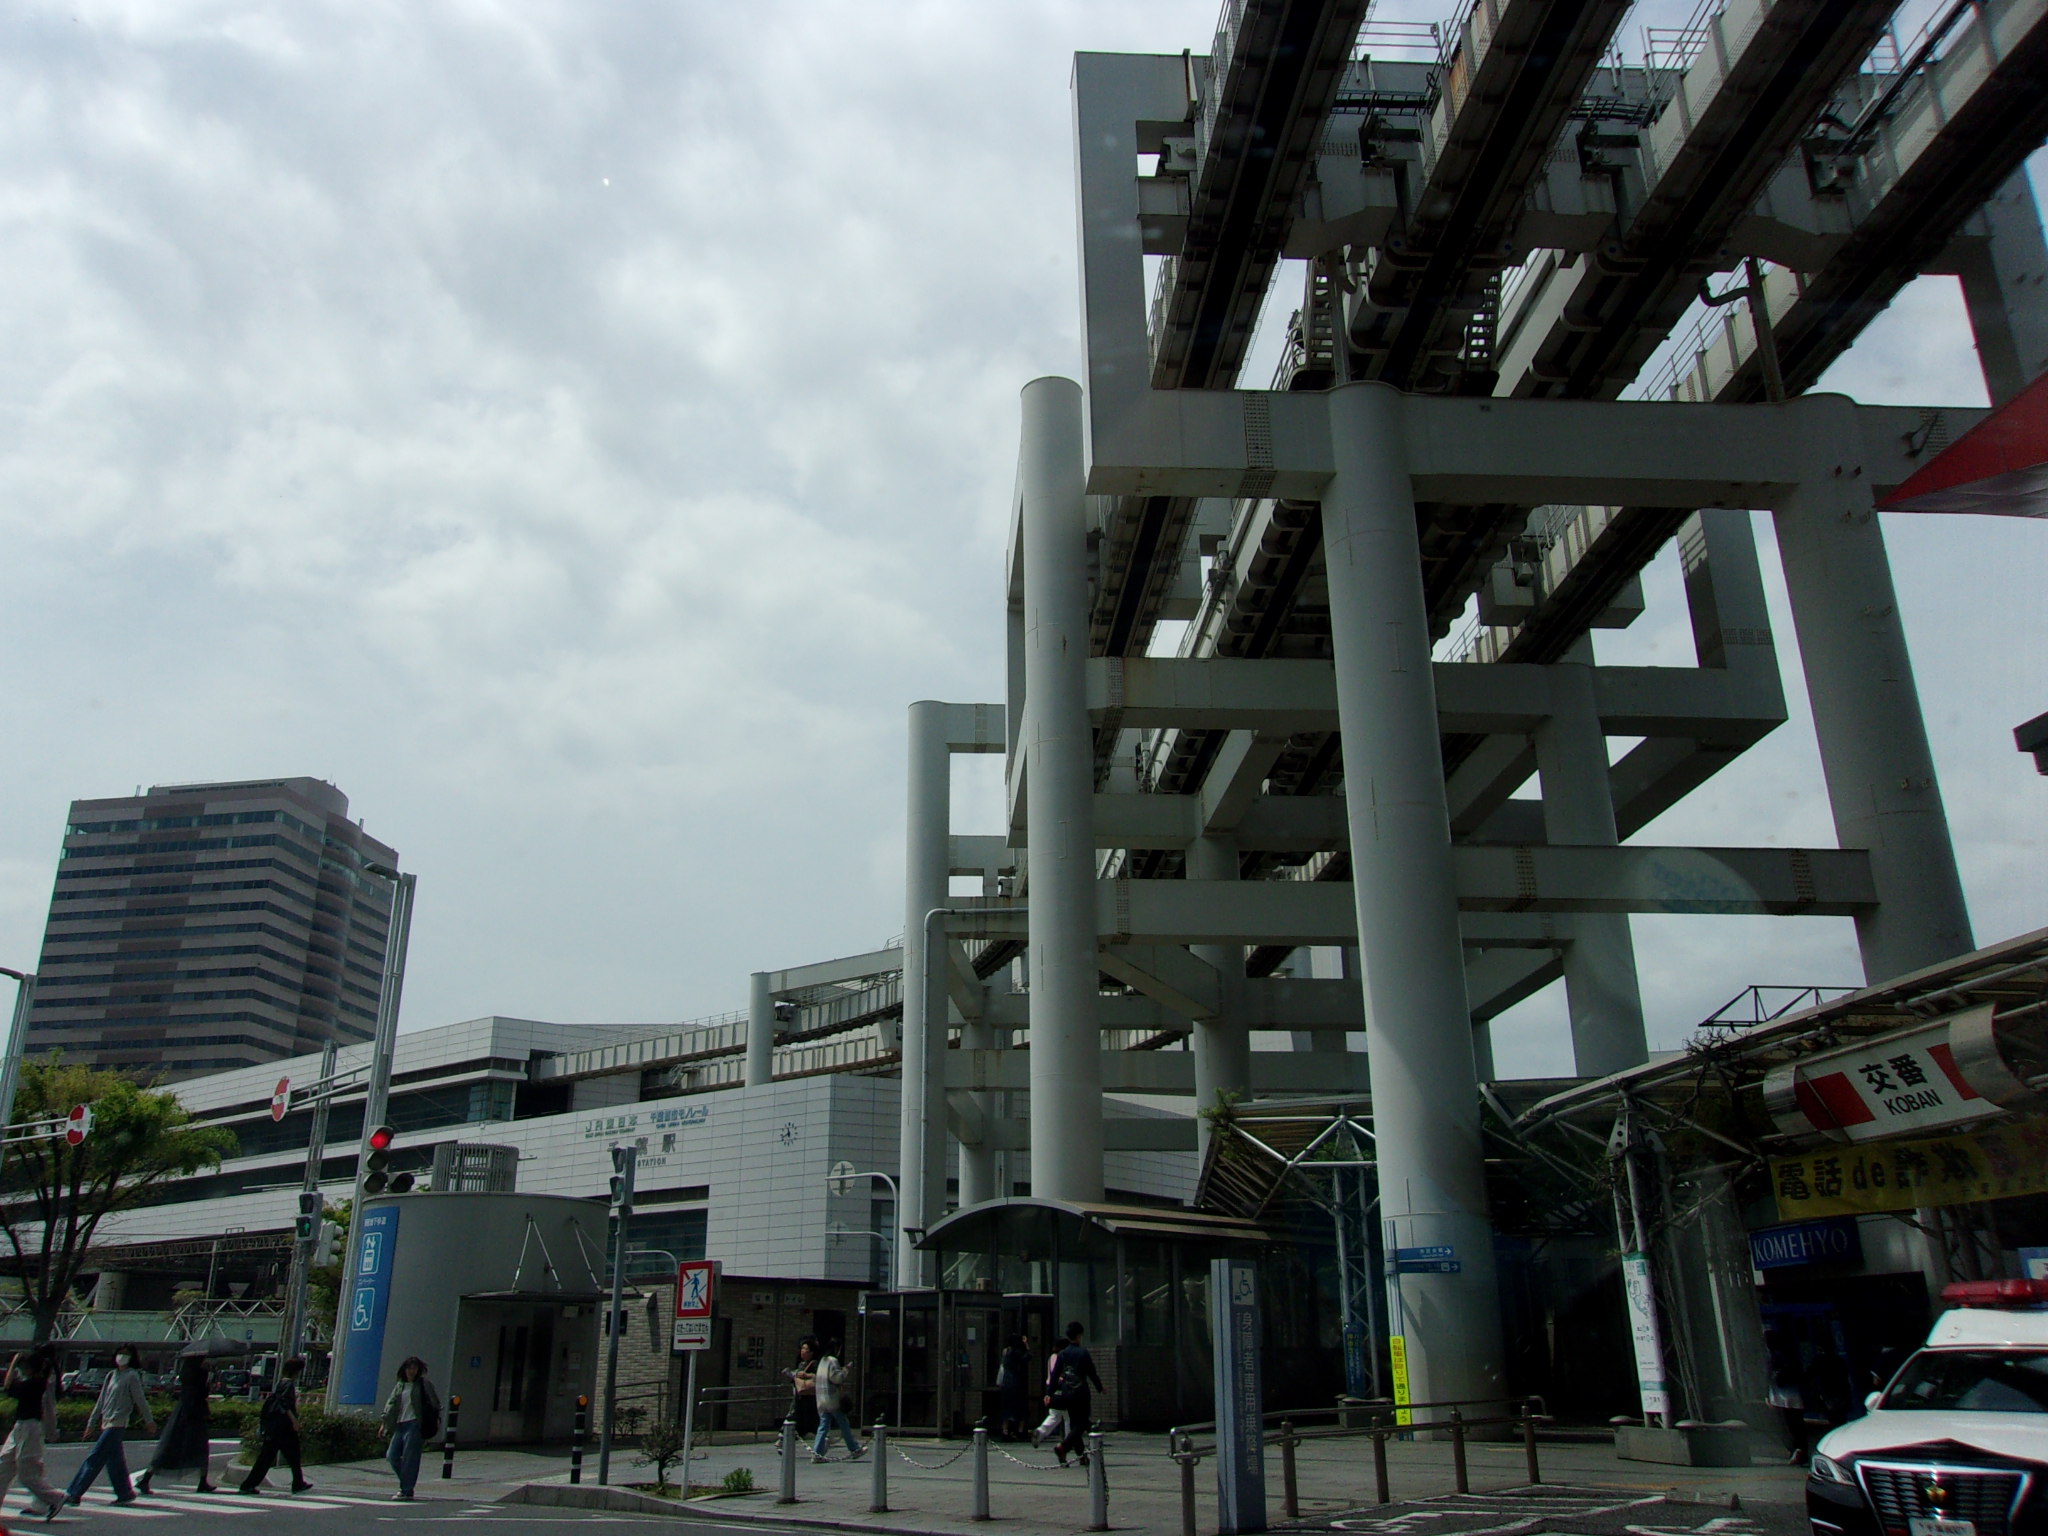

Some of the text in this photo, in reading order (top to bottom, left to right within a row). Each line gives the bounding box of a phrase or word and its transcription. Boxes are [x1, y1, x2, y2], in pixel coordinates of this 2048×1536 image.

[1858, 1053, 1928, 1095] 交番
[1883, 1088, 1944, 1116] KOBAN
[637, 1157, 667, 1168] STATION
[1753, 1228, 1848, 1263] KOMEHYO
[1391, 1338, 1407, 1423] 自転車は降りて通りまょう
